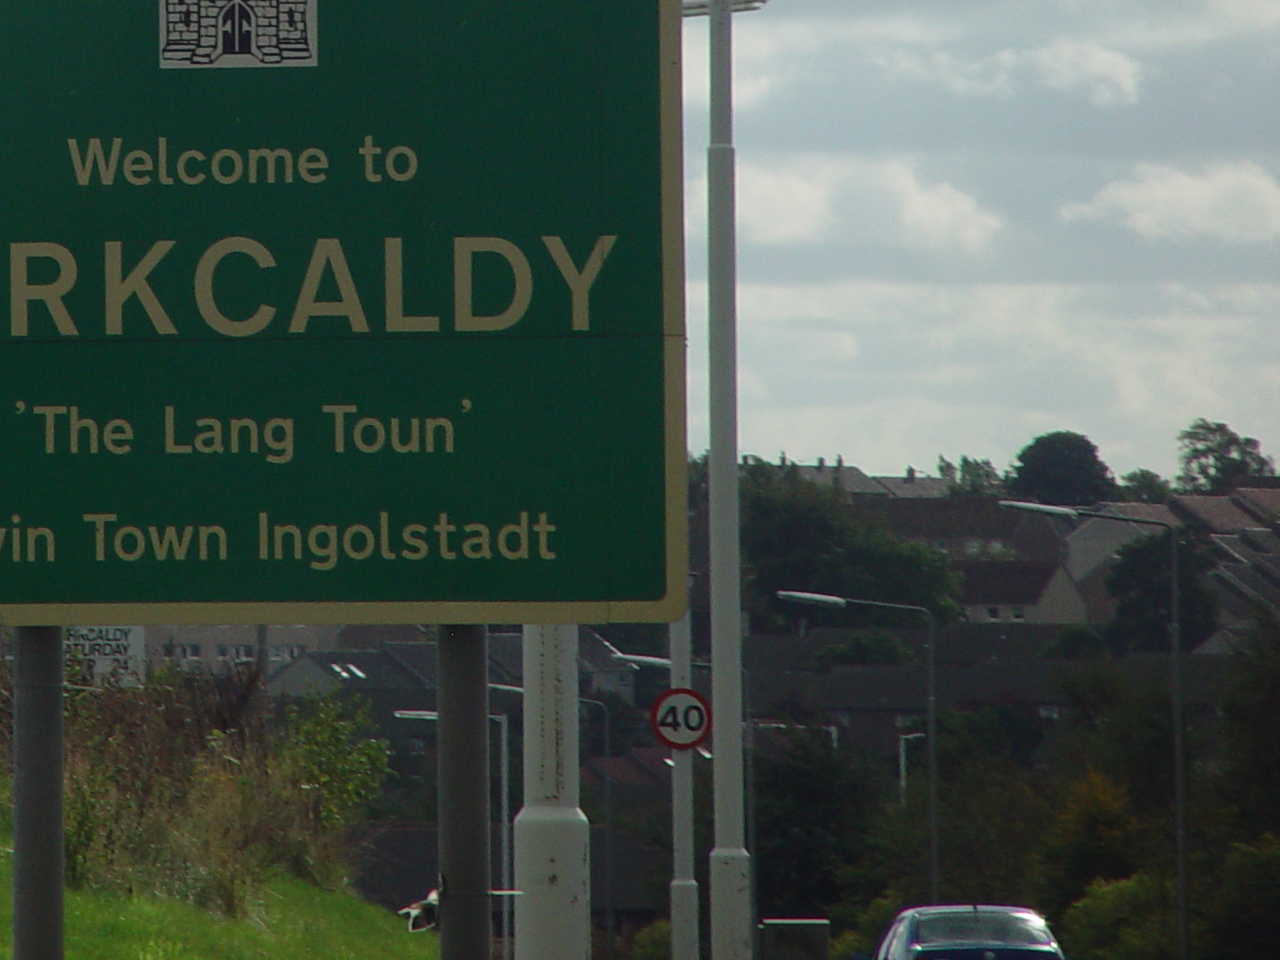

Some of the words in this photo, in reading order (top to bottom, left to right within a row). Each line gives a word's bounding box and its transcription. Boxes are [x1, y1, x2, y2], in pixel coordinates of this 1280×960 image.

[67, 137, 329, 187] Welcome
[358, 135, 419, 183] to
[165, 406, 294, 464] Lang
[322, 399, 472, 454] Toun'
[83, 513, 227, 561] Town
[259, 511, 556, 570] Ingolstadt
[63, 642, 130, 656] ATURDAY
[659, 705, 705, 732] 40
